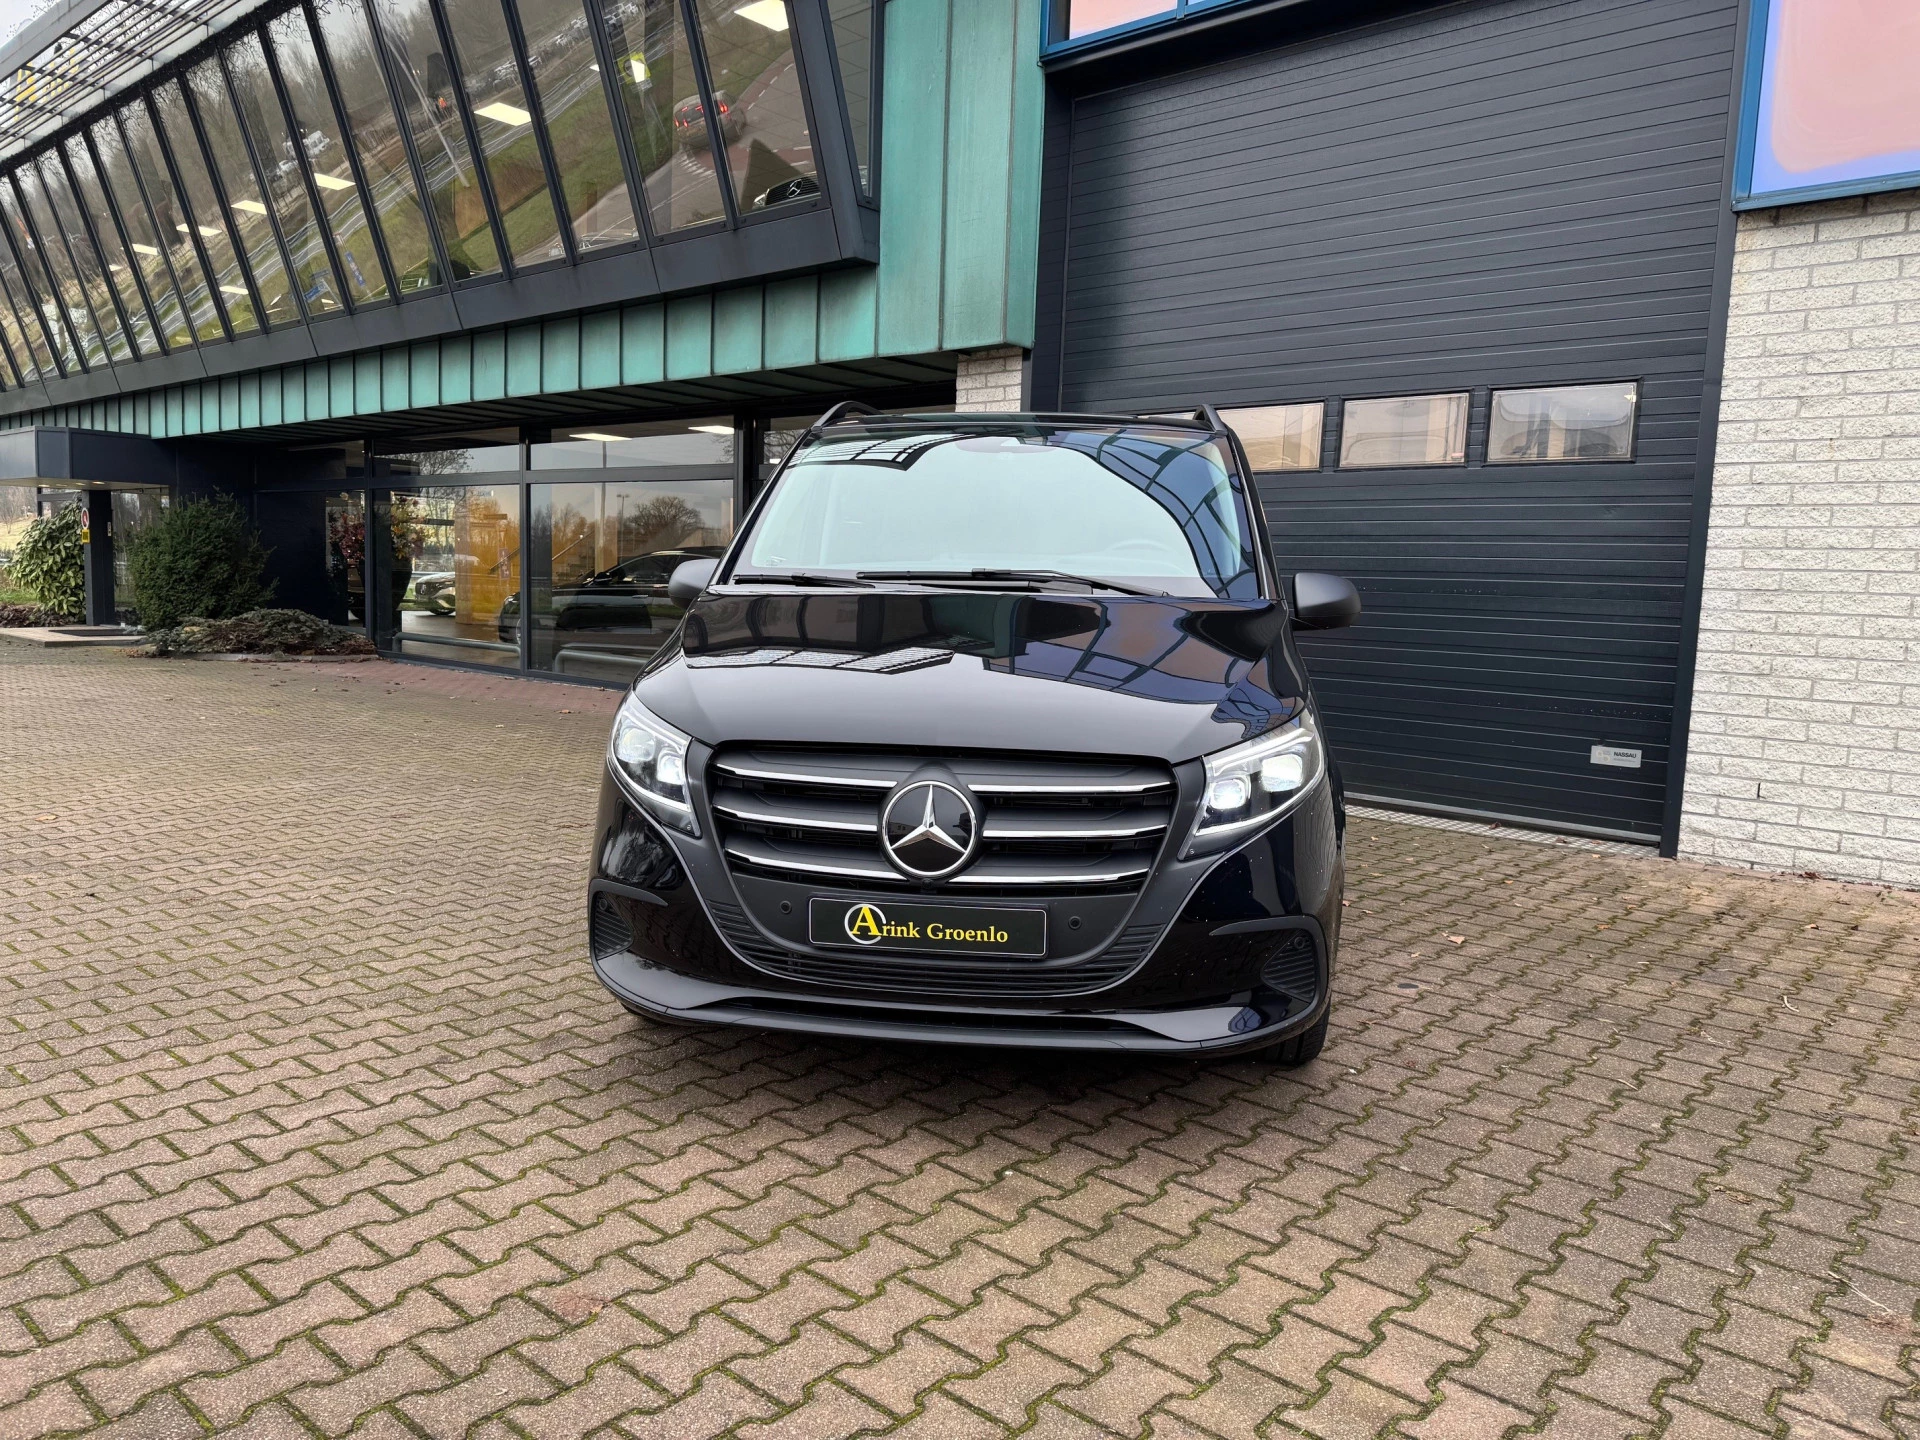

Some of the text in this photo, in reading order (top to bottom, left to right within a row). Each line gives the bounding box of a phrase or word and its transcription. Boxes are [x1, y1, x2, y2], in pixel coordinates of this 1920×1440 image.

[1613, 751, 1637, 759] NASSAU
[851, 905, 1009, 943] Arink Groenlo
